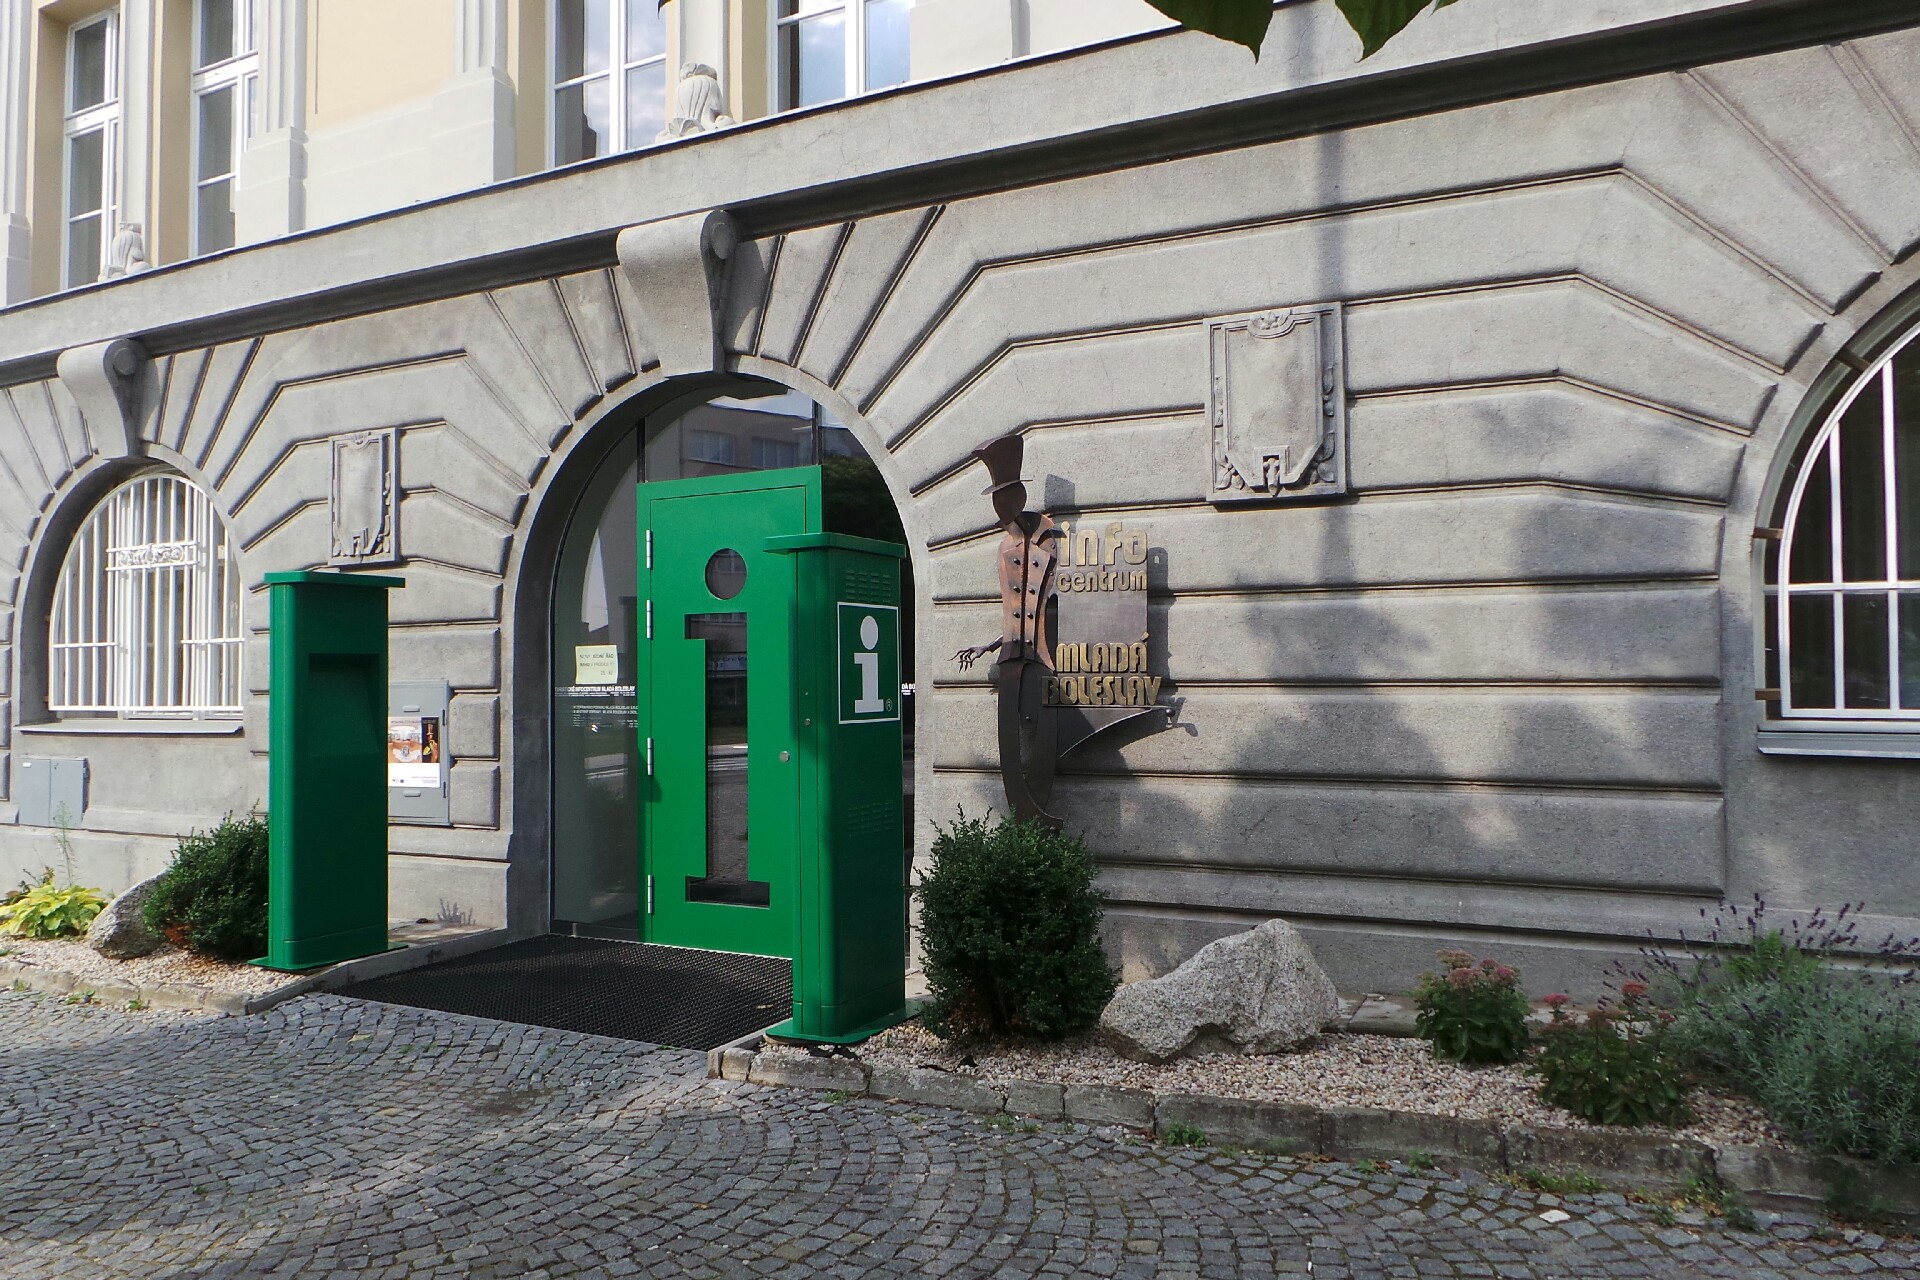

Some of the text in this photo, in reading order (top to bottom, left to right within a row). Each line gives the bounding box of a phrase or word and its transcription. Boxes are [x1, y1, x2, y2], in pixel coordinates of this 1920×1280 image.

[1058, 521, 1148, 567] info
[1057, 565, 1148, 593] centrum
[1056, 632, 1150, 674] MLADÁ
[1041, 675, 1162, 706] BOLESLAV
